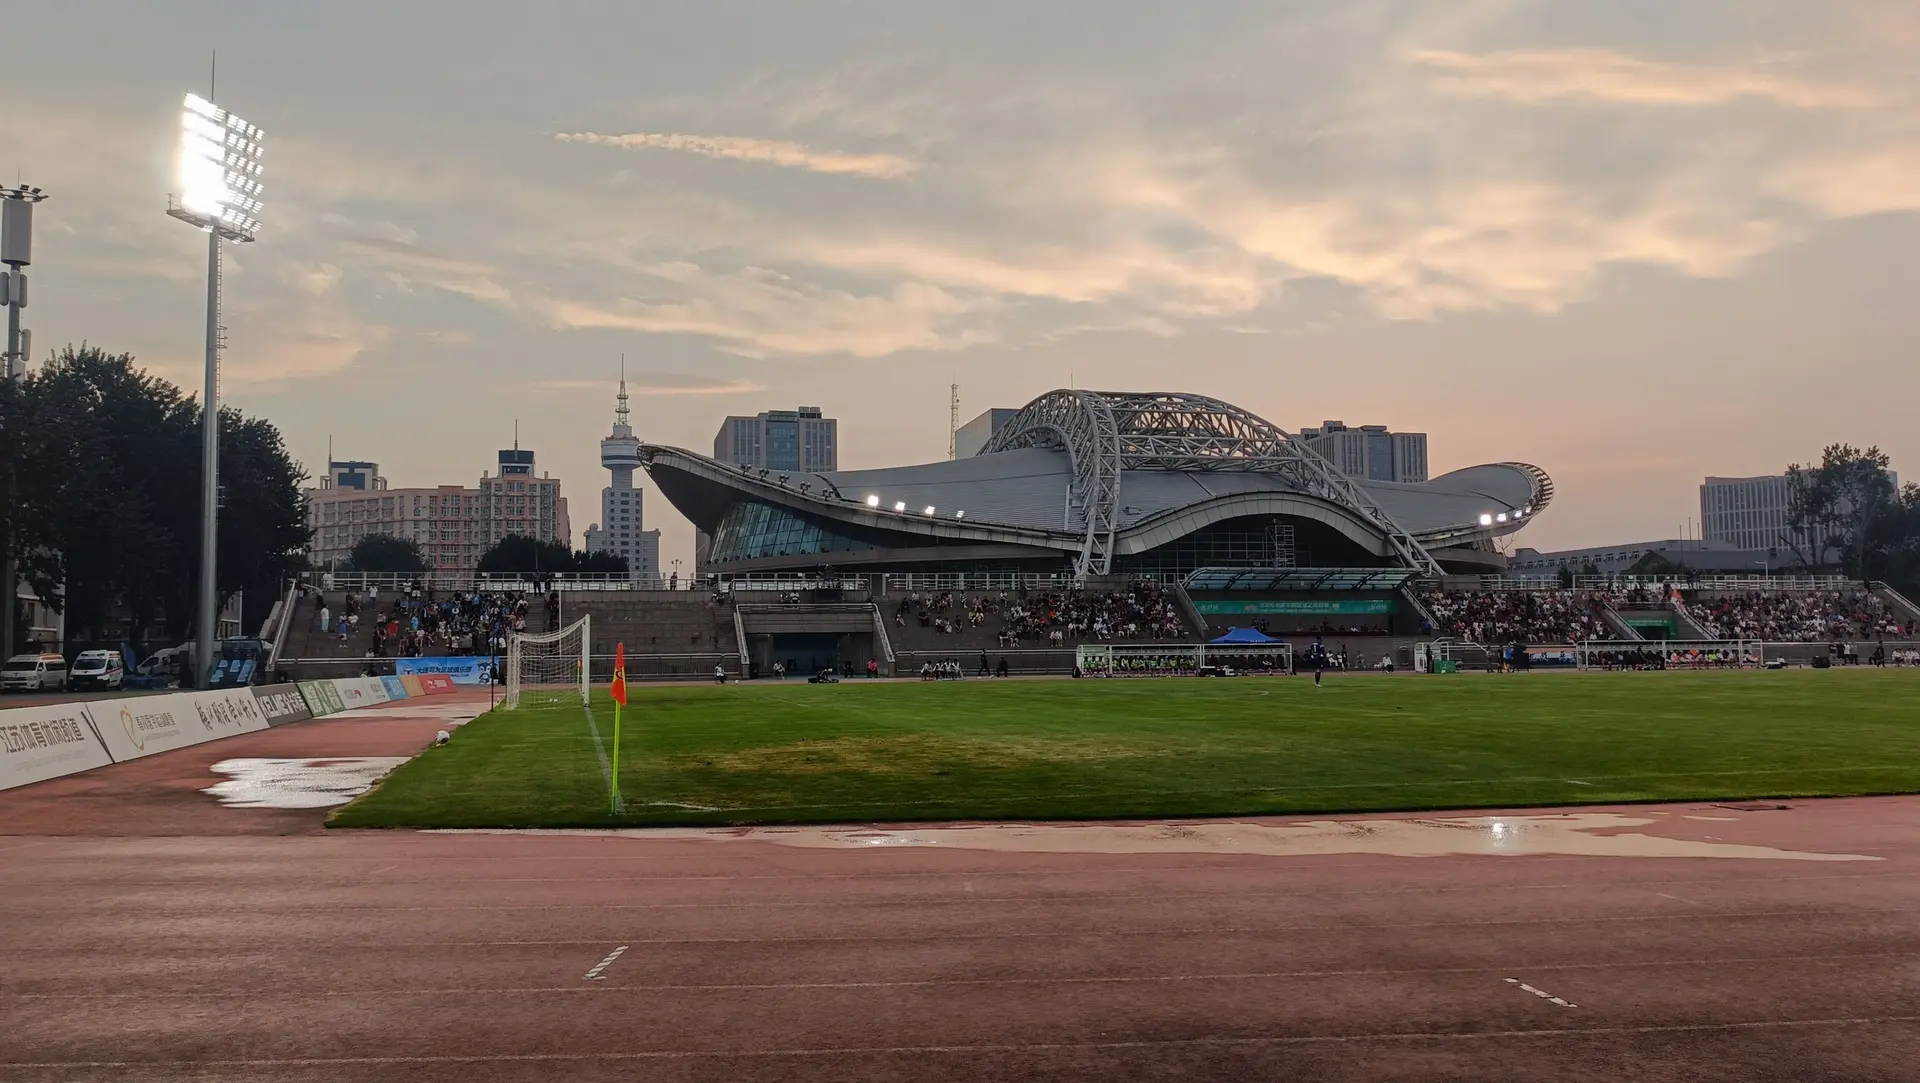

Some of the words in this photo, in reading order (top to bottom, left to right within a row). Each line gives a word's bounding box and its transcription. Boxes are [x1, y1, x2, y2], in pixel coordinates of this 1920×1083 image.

[257, 694, 290, 718] KELME
[0, 717, 84, 753] 江苏体育休闲频道
